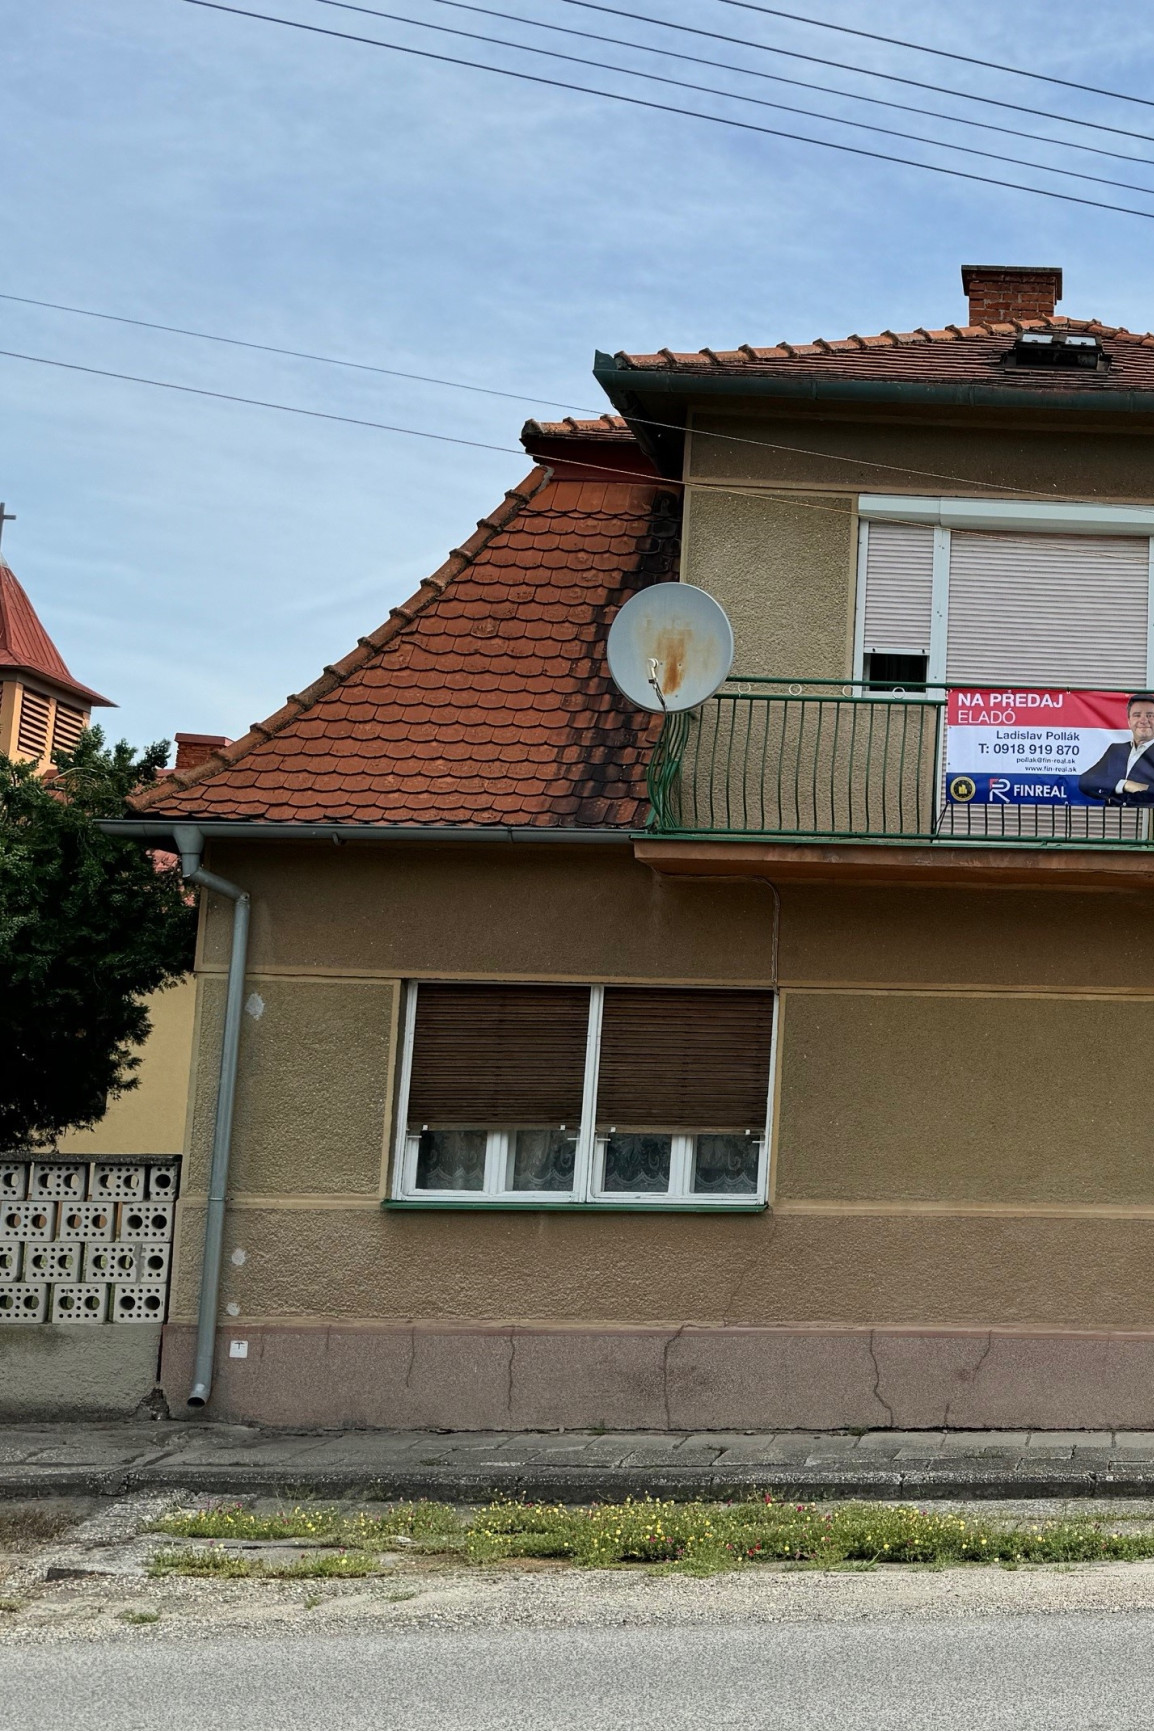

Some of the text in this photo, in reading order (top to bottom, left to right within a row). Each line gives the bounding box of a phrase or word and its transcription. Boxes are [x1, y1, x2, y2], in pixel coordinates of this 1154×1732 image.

[958, 693, 1063, 708] NA PREDAJ
[958, 708, 1016, 724] ELADÓ
[996, 730, 1080, 741] Ladislav Pollák
[978, 743, 1080, 756] T: 0918 919 870
[1013, 784, 1067, 798] FINREAL
